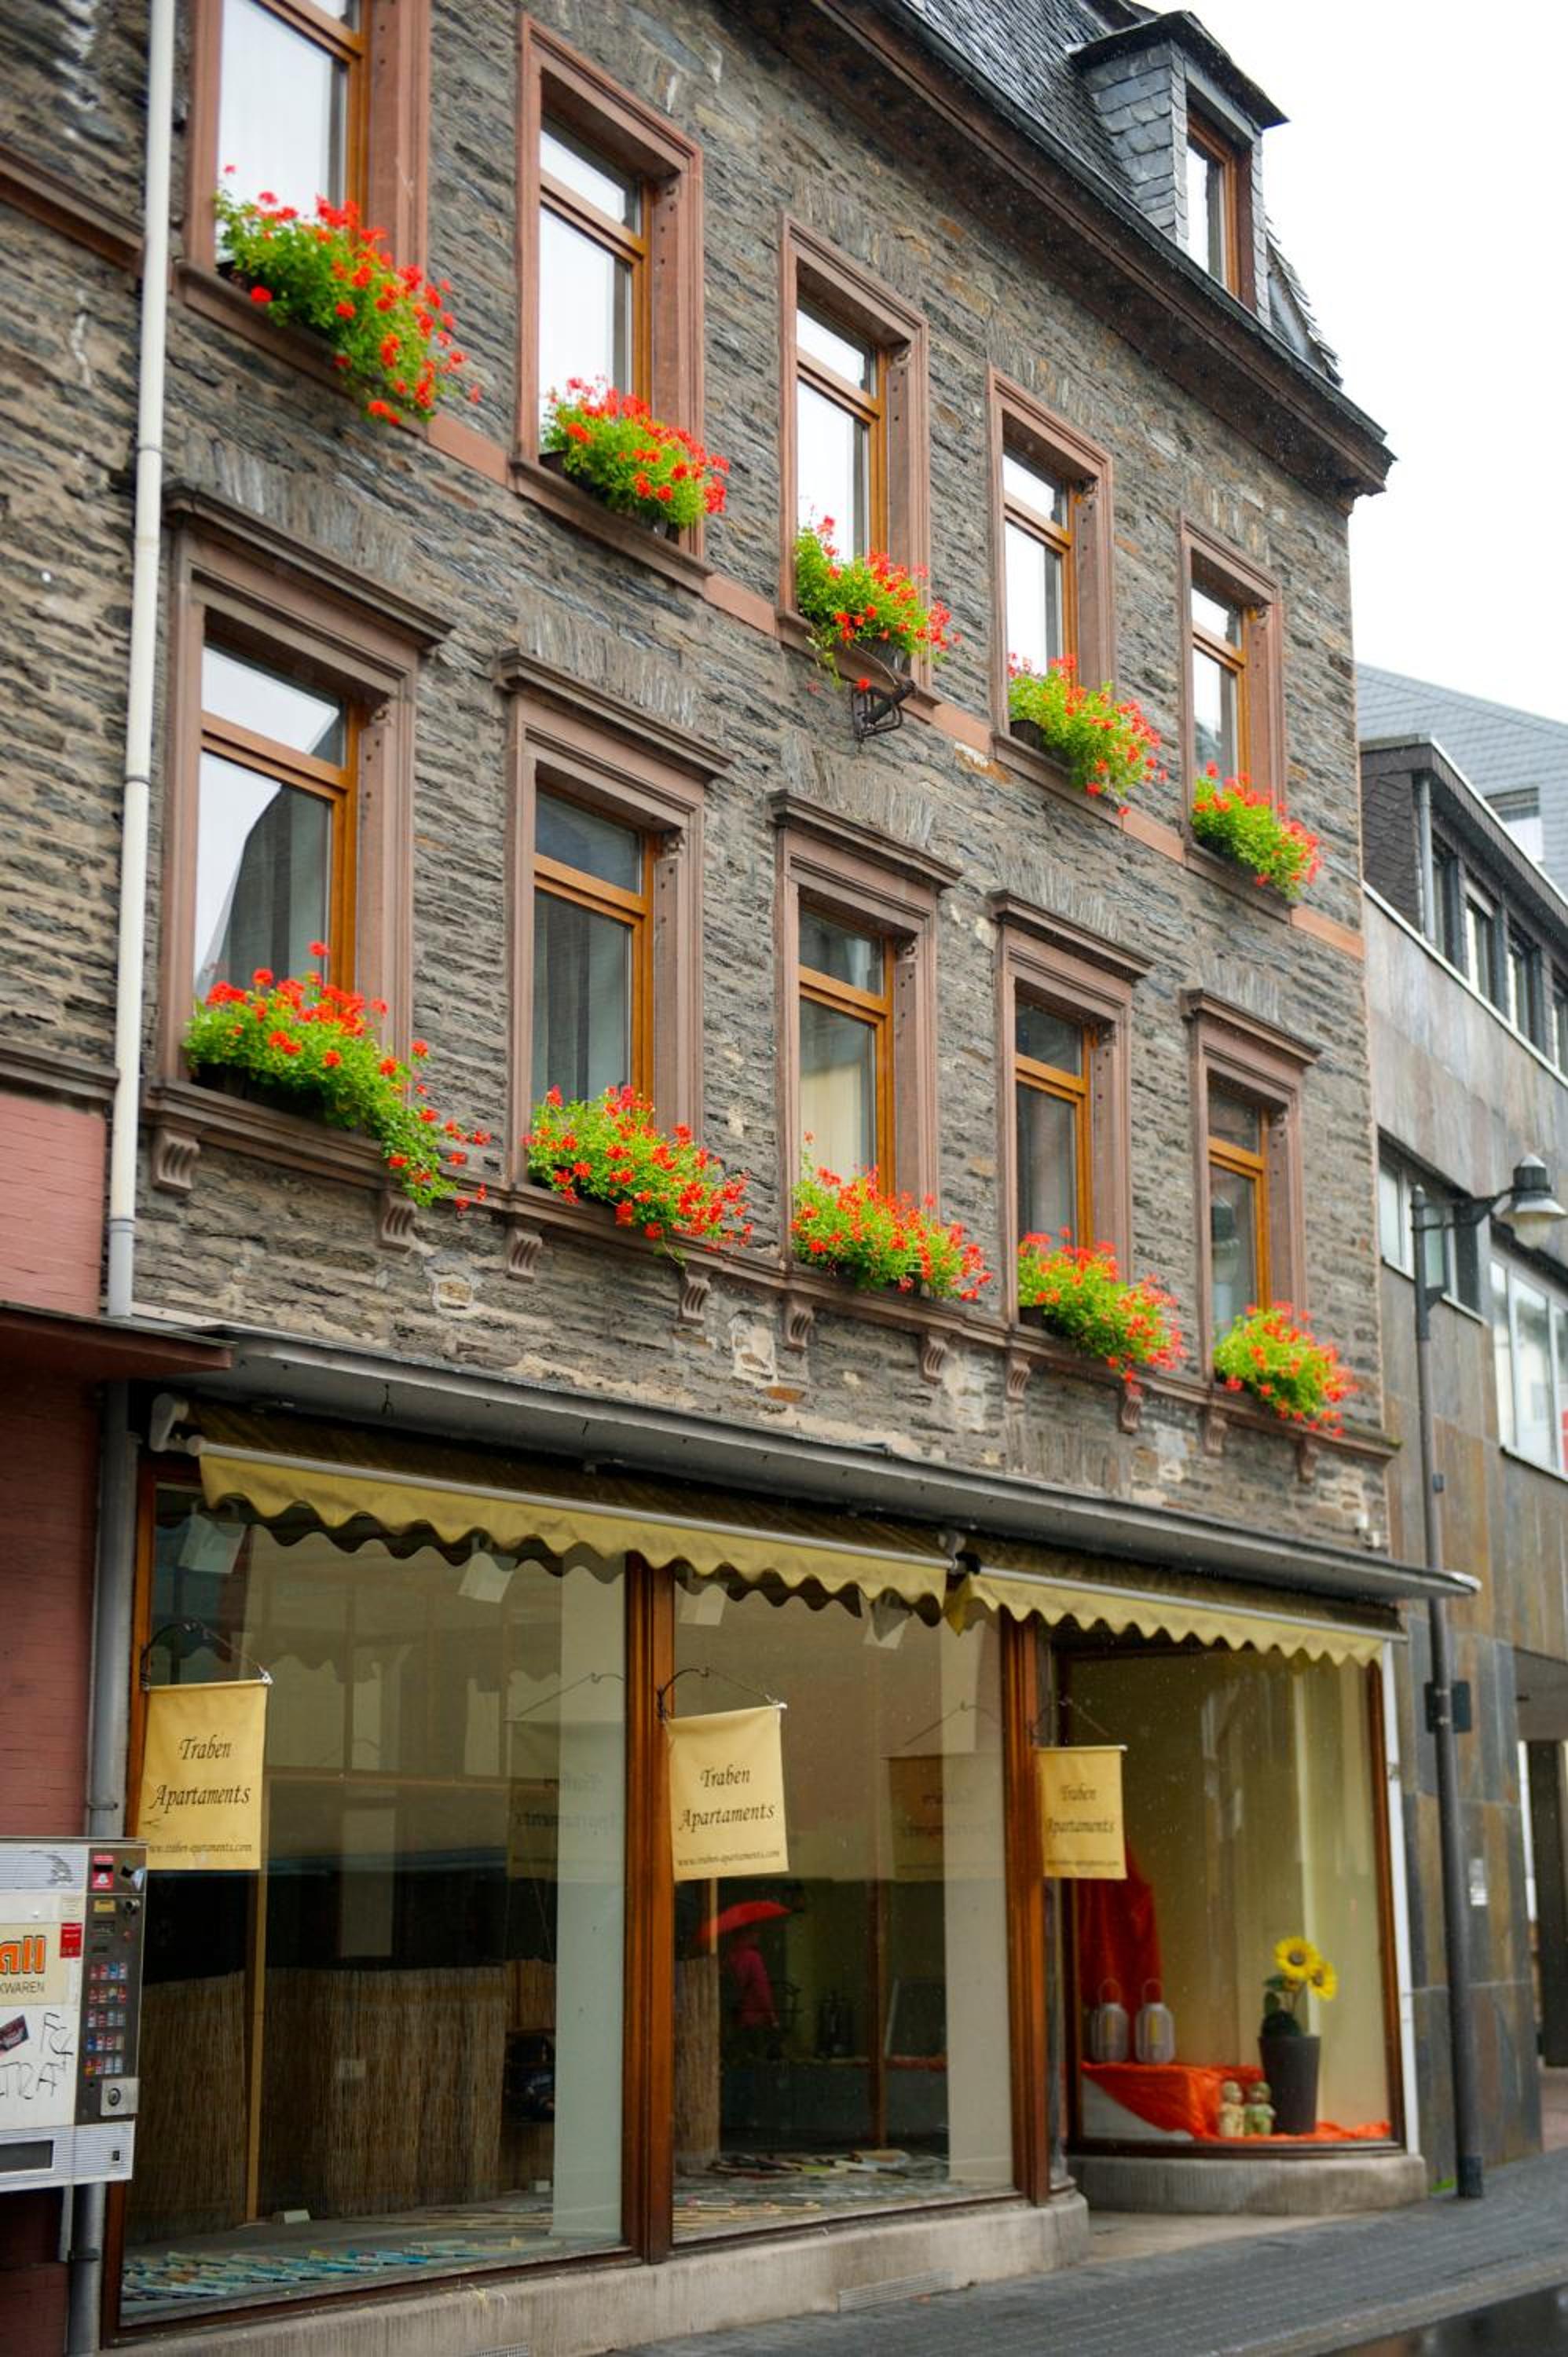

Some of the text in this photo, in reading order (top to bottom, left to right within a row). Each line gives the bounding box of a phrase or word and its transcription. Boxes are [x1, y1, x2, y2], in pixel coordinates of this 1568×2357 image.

[179, 1734, 232, 1761] Traben
[699, 1764, 751, 1788] Traben
[148, 1784, 251, 1813] Apartaments
[678, 1803, 775, 1832] Apartaments
